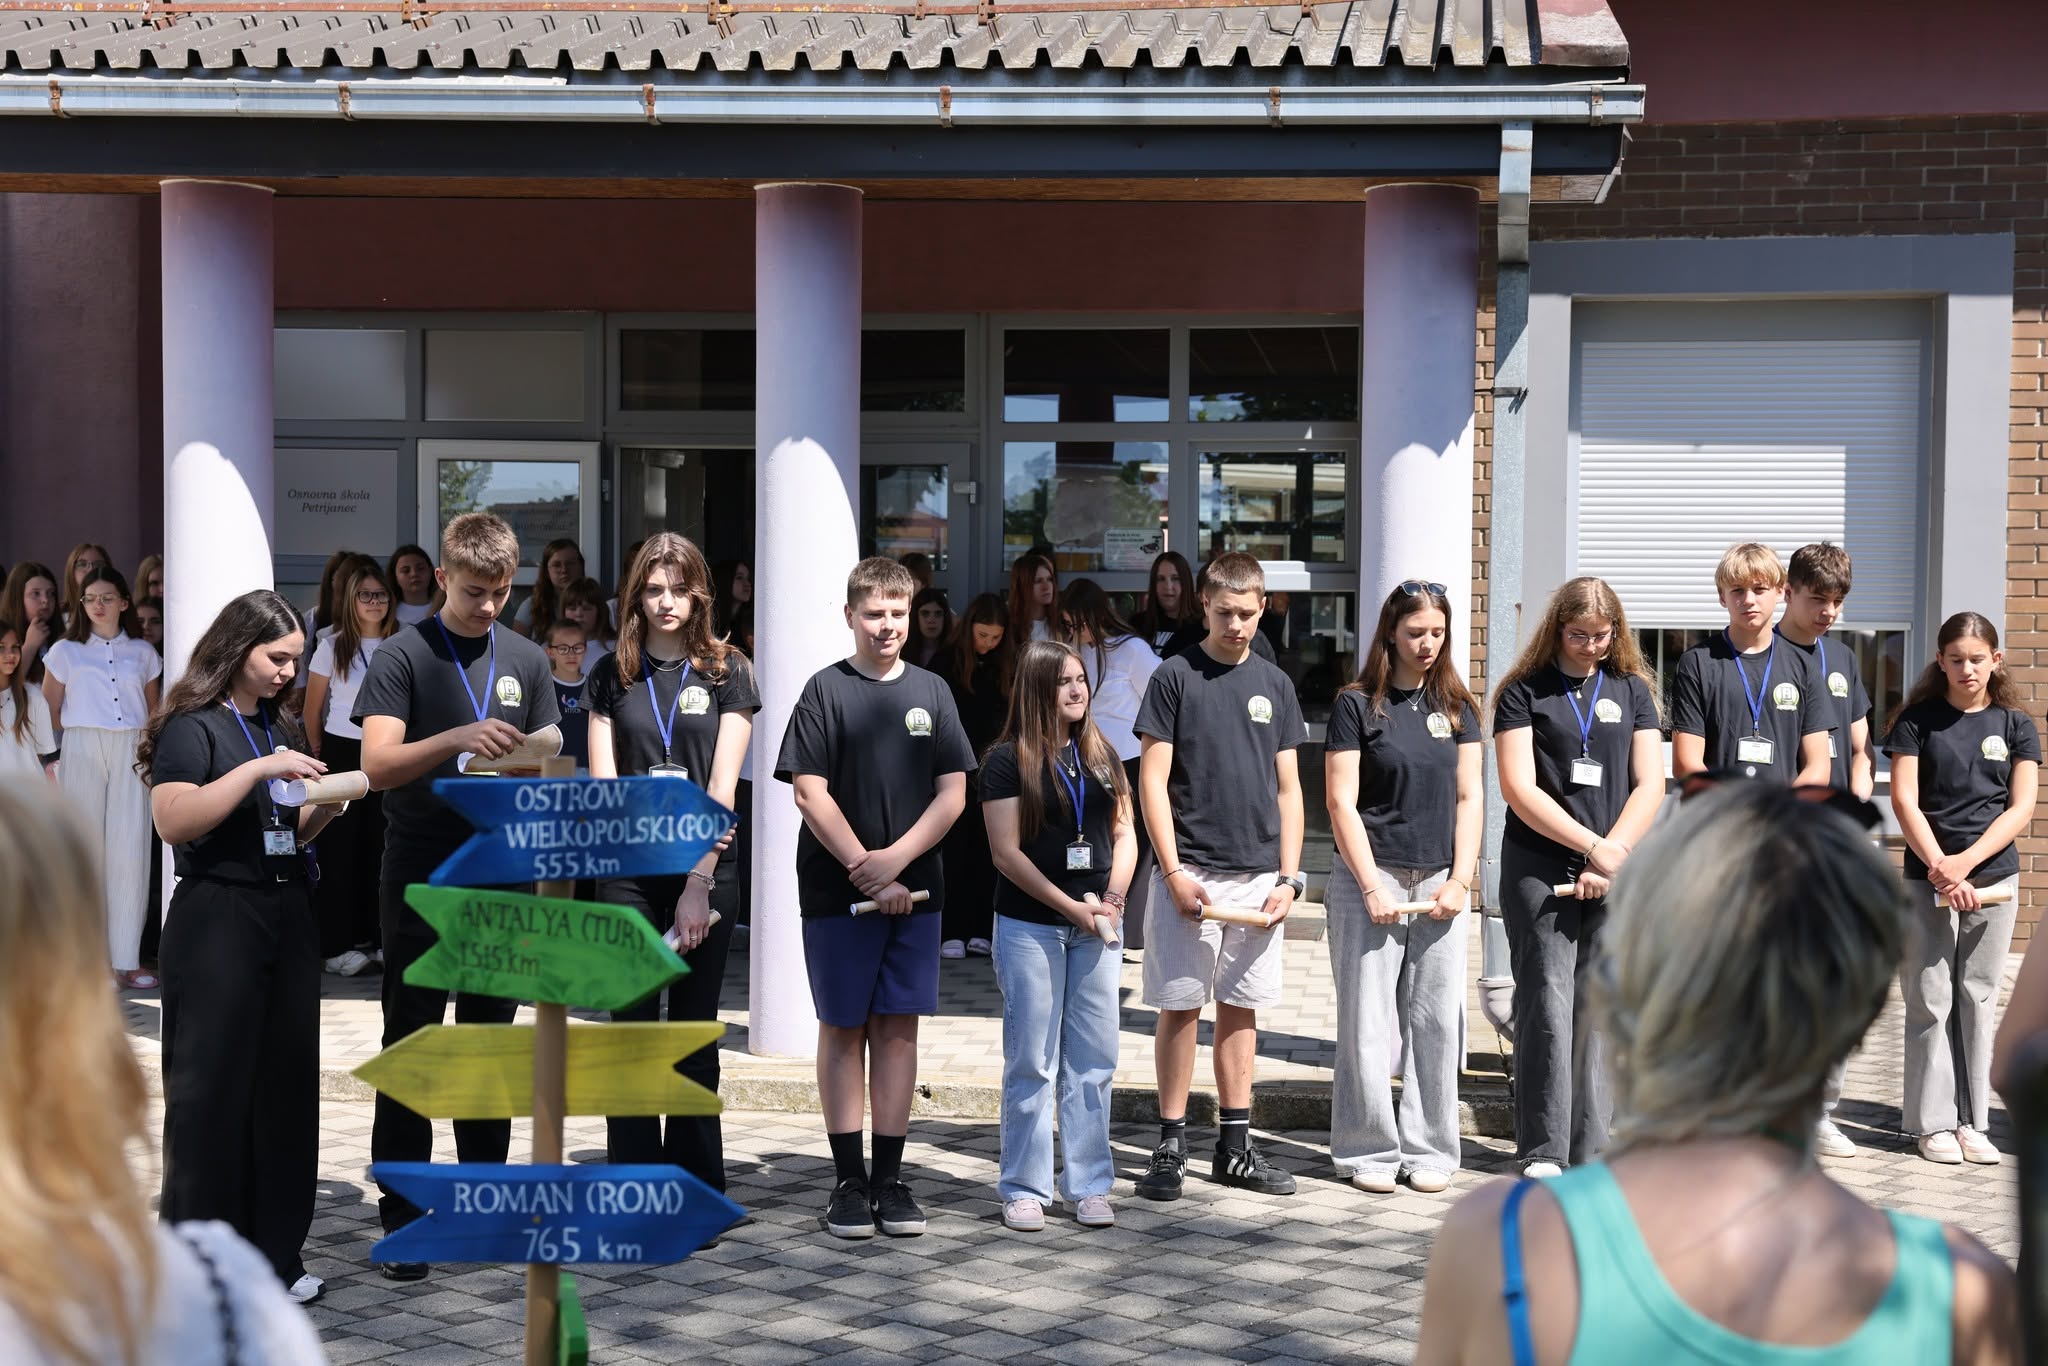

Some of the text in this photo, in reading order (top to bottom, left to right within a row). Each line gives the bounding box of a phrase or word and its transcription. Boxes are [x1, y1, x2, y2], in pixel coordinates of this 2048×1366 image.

[287, 488, 371, 501] Osnovna škola
[301, 501, 358, 515] Petrijanec
[505, 816, 675, 849] WIELKOPOLSKI
[533, 850, 621, 880] 555 km
[459, 899, 646, 953] ANTALYA (TUR)
[453, 1180, 685, 1216] ROMAN (ROM)
[522, 1226, 643, 1263] 765 km
